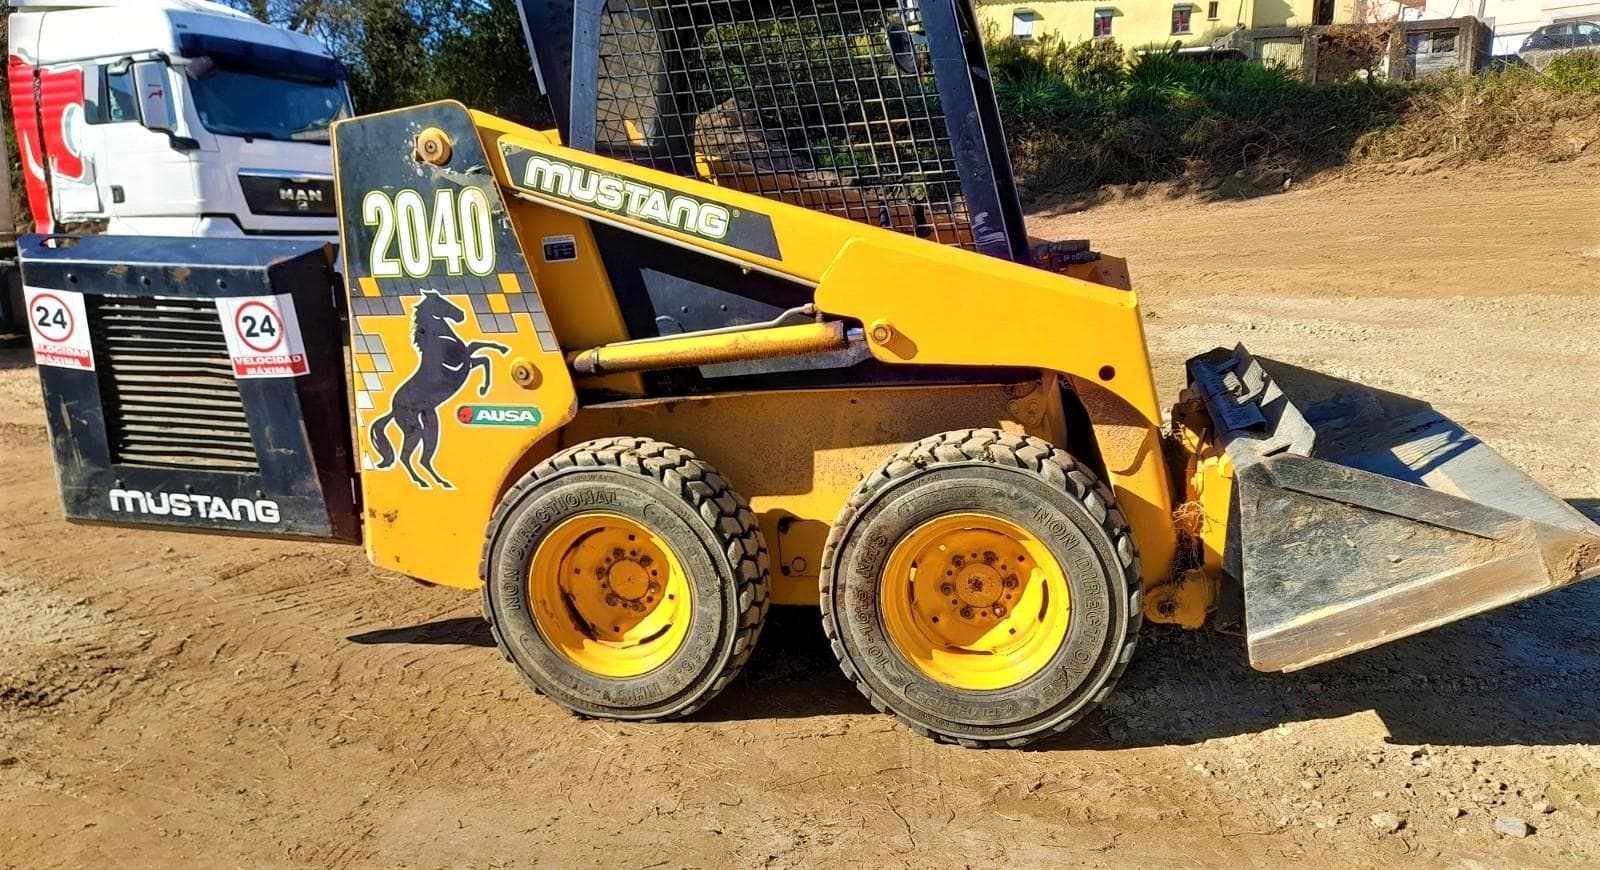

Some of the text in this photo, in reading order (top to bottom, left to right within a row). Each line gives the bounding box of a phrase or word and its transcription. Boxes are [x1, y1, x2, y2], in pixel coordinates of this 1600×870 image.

[279, 188, 322, 202] MAN
[524, 155, 730, 239] MUSTANG
[362, 186, 496, 278] 2040
[35, 306, 67, 329] 24
[241, 315, 276, 338] 24
[233, 354, 301, 365] VELOCIDAD
[476, 409, 537, 422] AUSA
[109, 488, 281, 524] MUSTANG
[507, 489, 622, 561] DIRECTIONAL
[1030, 504, 1081, 552] NON
[503, 566, 521, 611] NON
